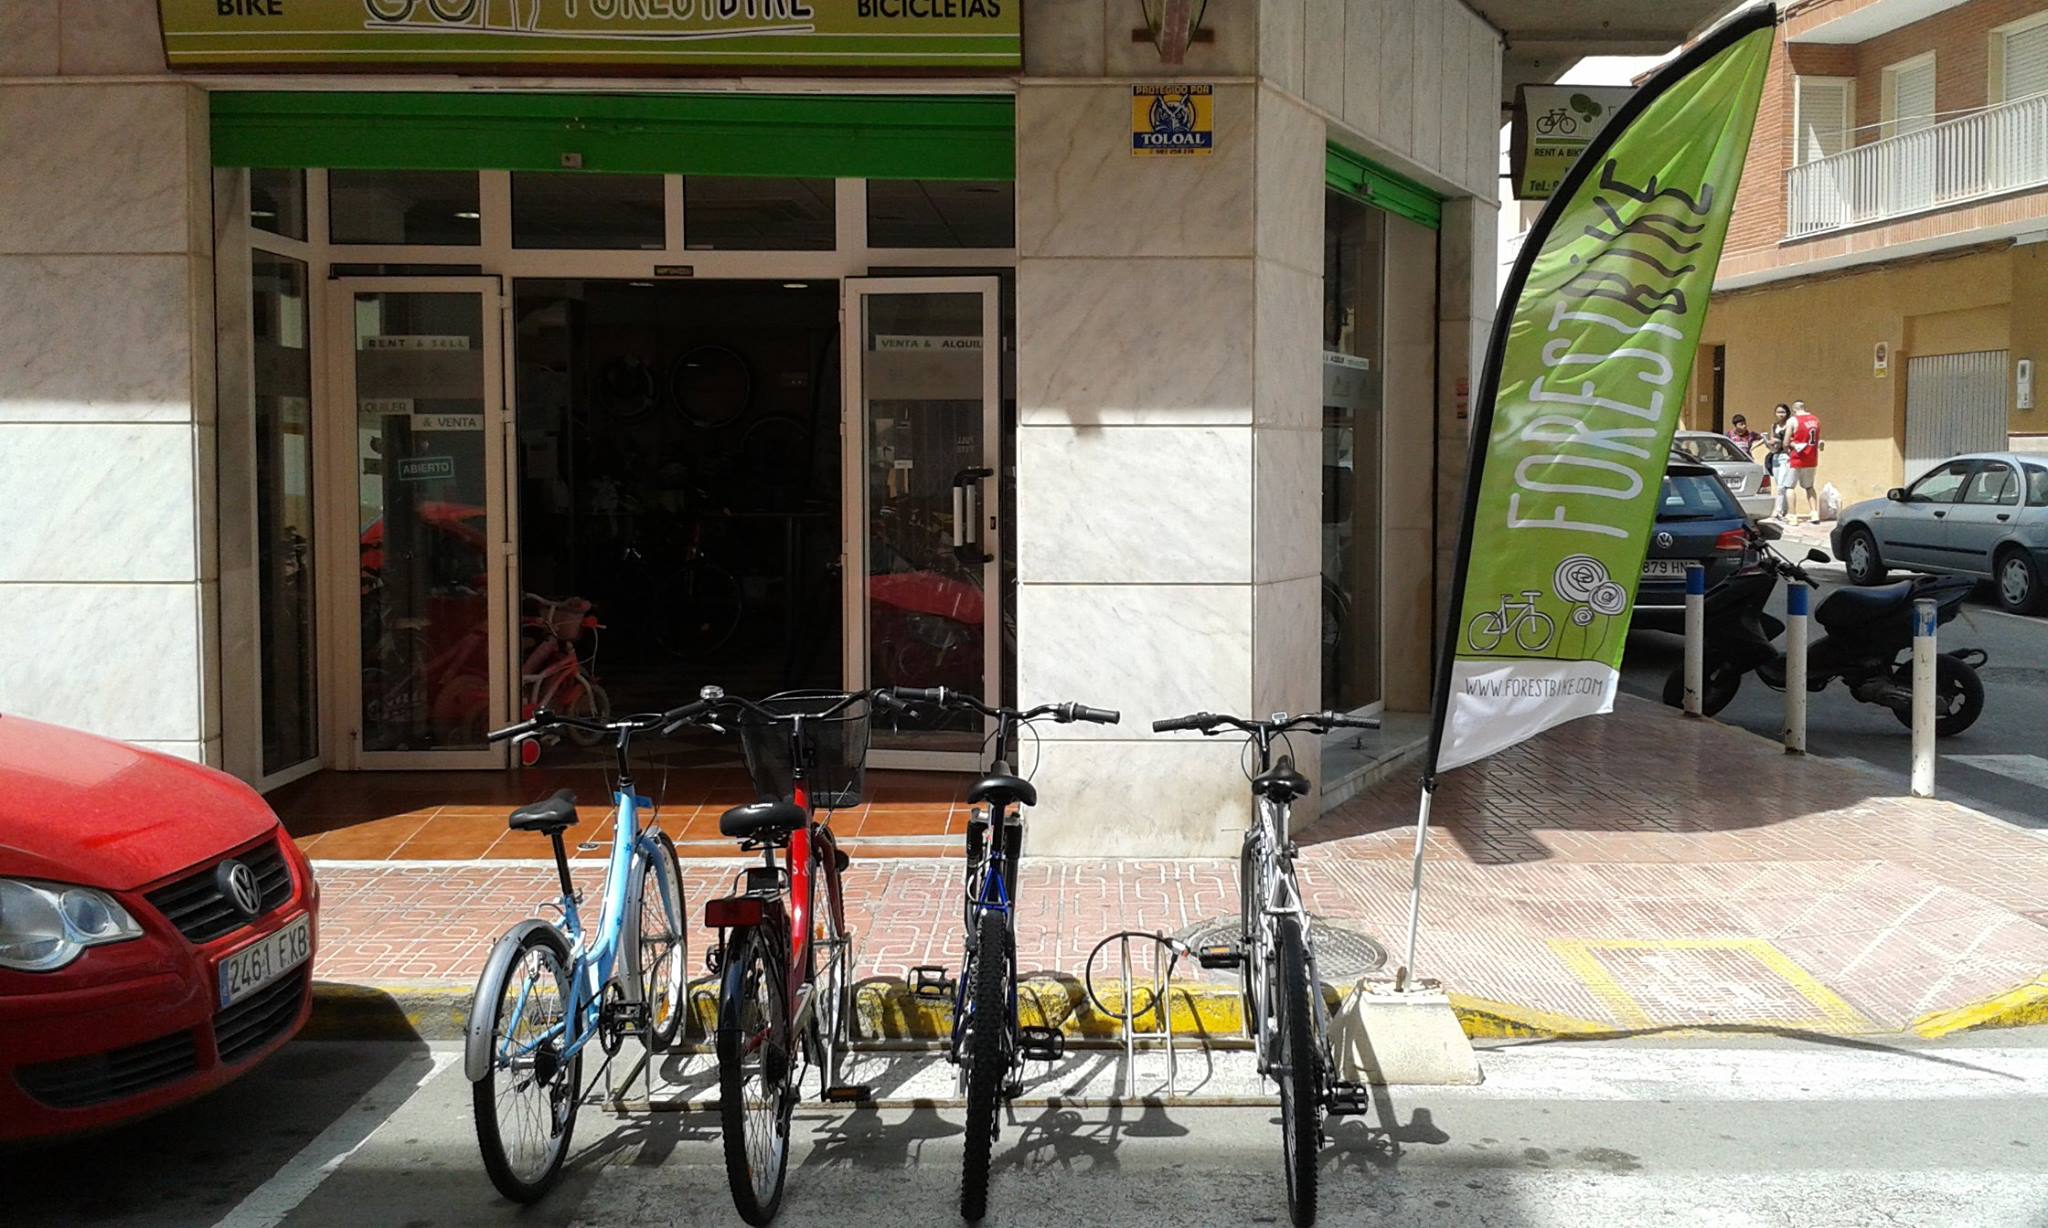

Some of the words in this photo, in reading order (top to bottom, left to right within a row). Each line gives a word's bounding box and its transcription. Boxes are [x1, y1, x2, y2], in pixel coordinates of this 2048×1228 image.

[217, 0, 283, 16] BIKE
[857, 0, 1000, 18] BICICLETAS
[1135, 85, 1188, 94] PROTEGIDO
[1190, 85, 1210, 94] POR
[1141, 133, 1205, 145] TOLOAL
[1534, 148, 1555, 157] RENT
[1558, 149, 1565, 157] A
[1566, 148, 1583, 157] BIK
[368, 339, 405, 348] RENT
[881, 340, 918, 349] VENTA
[1507, 158, 1713, 539] FORESTBIKE
[438, 417, 477, 427] VENTA
[403, 462, 449, 474] ABIERTO
[1465, 677, 1603, 697] WWW.FORESTBIKE.COM
[230, 942, 271, 995] 2461
[278, 924, 307, 968] FXB
